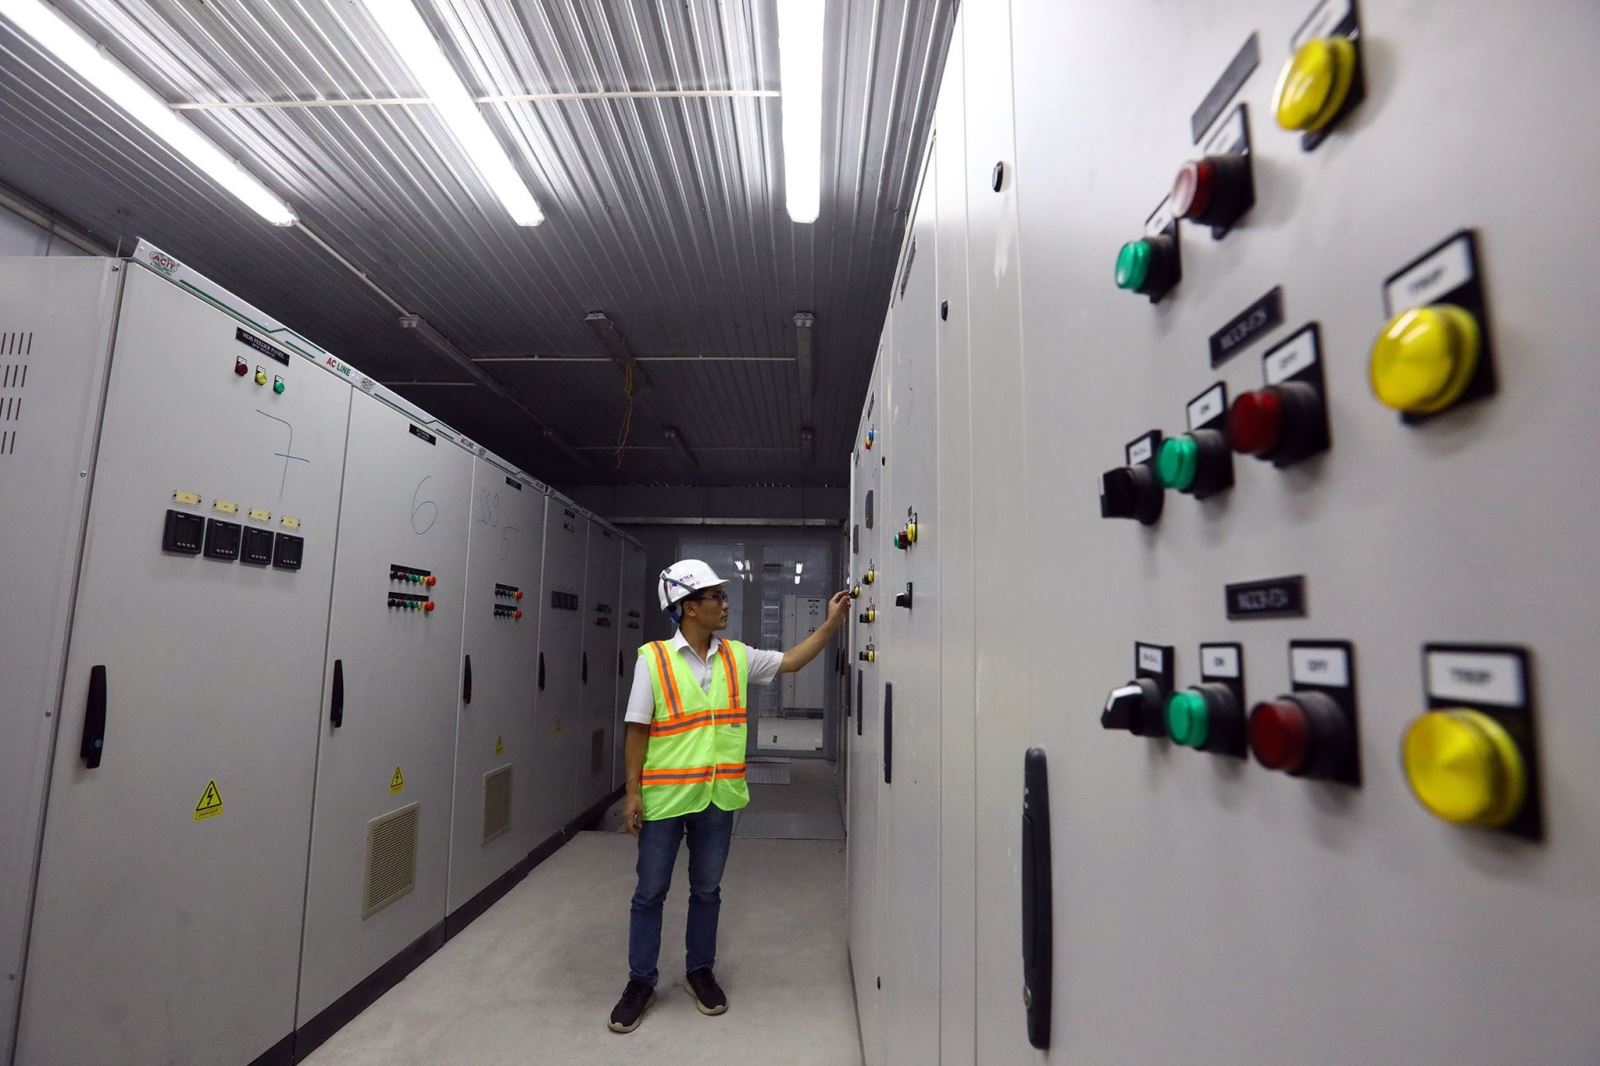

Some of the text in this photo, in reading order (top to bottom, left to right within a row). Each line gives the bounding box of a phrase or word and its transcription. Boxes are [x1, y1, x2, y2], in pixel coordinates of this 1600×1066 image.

[326, 357, 351, 377] AC LINE
[256, 409, 311, 504] 7
[411, 475, 438, 535] 6
